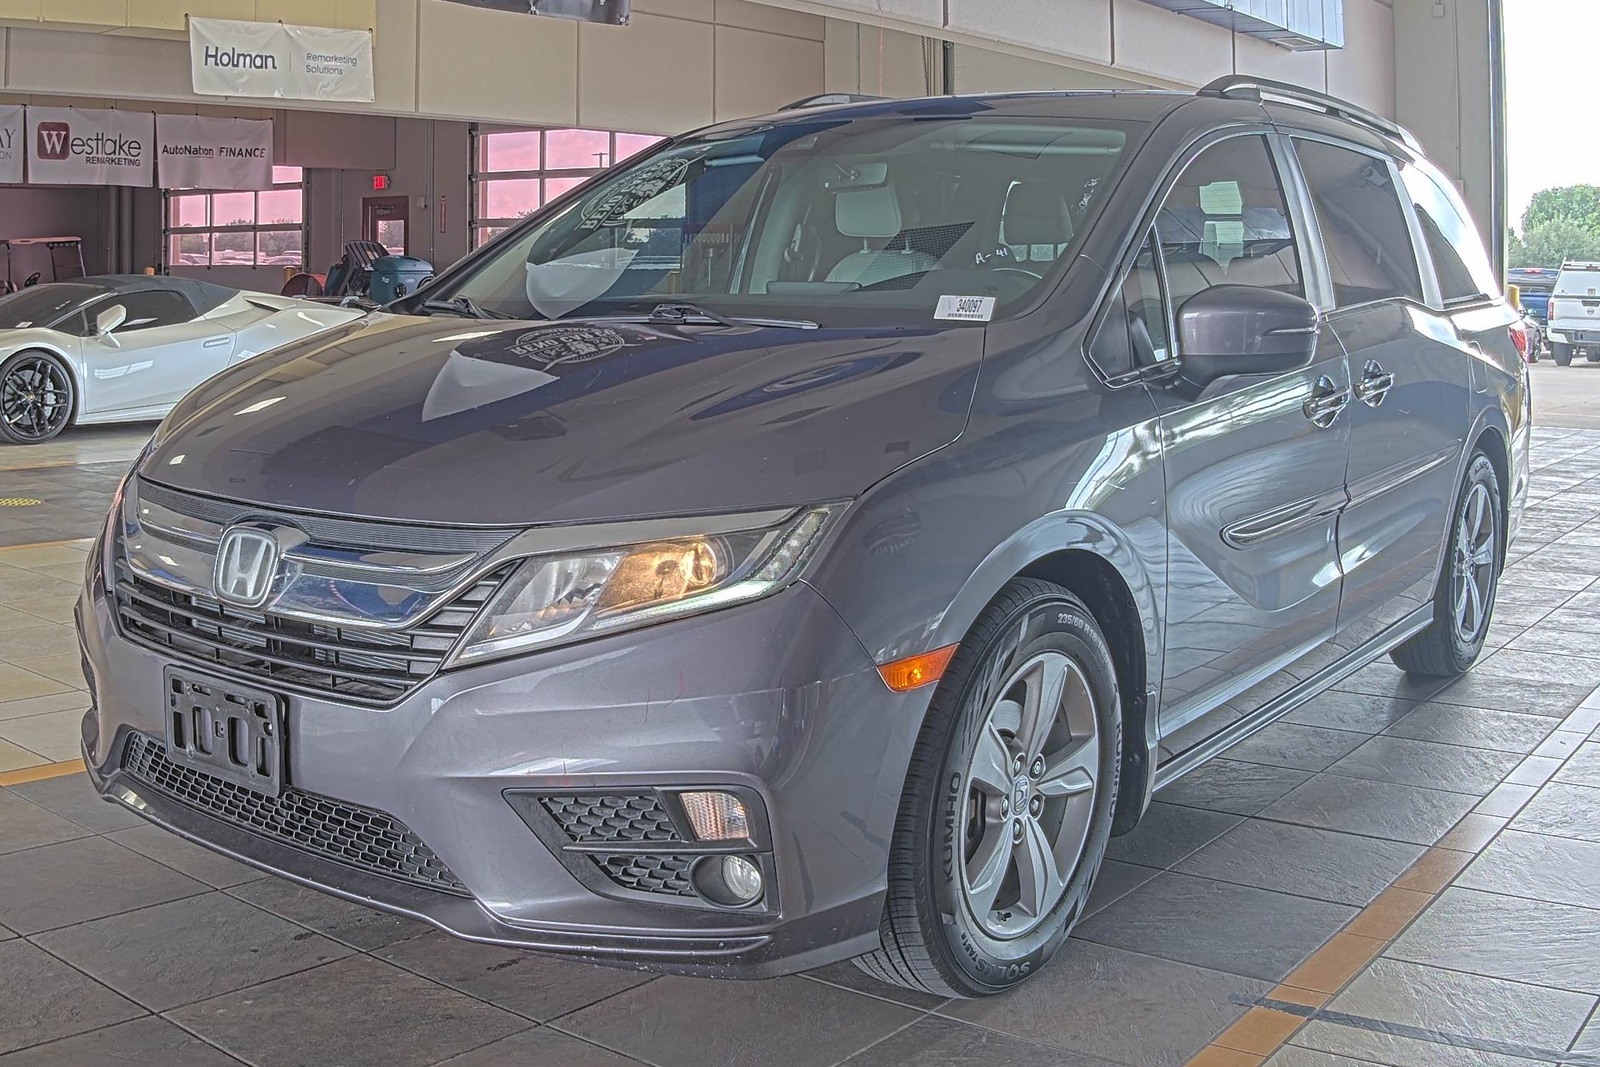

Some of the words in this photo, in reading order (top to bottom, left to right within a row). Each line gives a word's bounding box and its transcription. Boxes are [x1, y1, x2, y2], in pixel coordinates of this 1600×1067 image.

[204, 45, 278, 70] Holman
[306, 52, 358, 67] Remarketing
[305, 64, 344, 76] Solutions
[40, 130, 142, 158] Westlake
[161, 144, 215, 157] AutoNation
[219, 146, 267, 158] FINANCE
[85, 156, 142, 167] REMARKETING
[1057, 613, 1084, 629] 235/60
[942, 771, 962, 884] KUMHO
